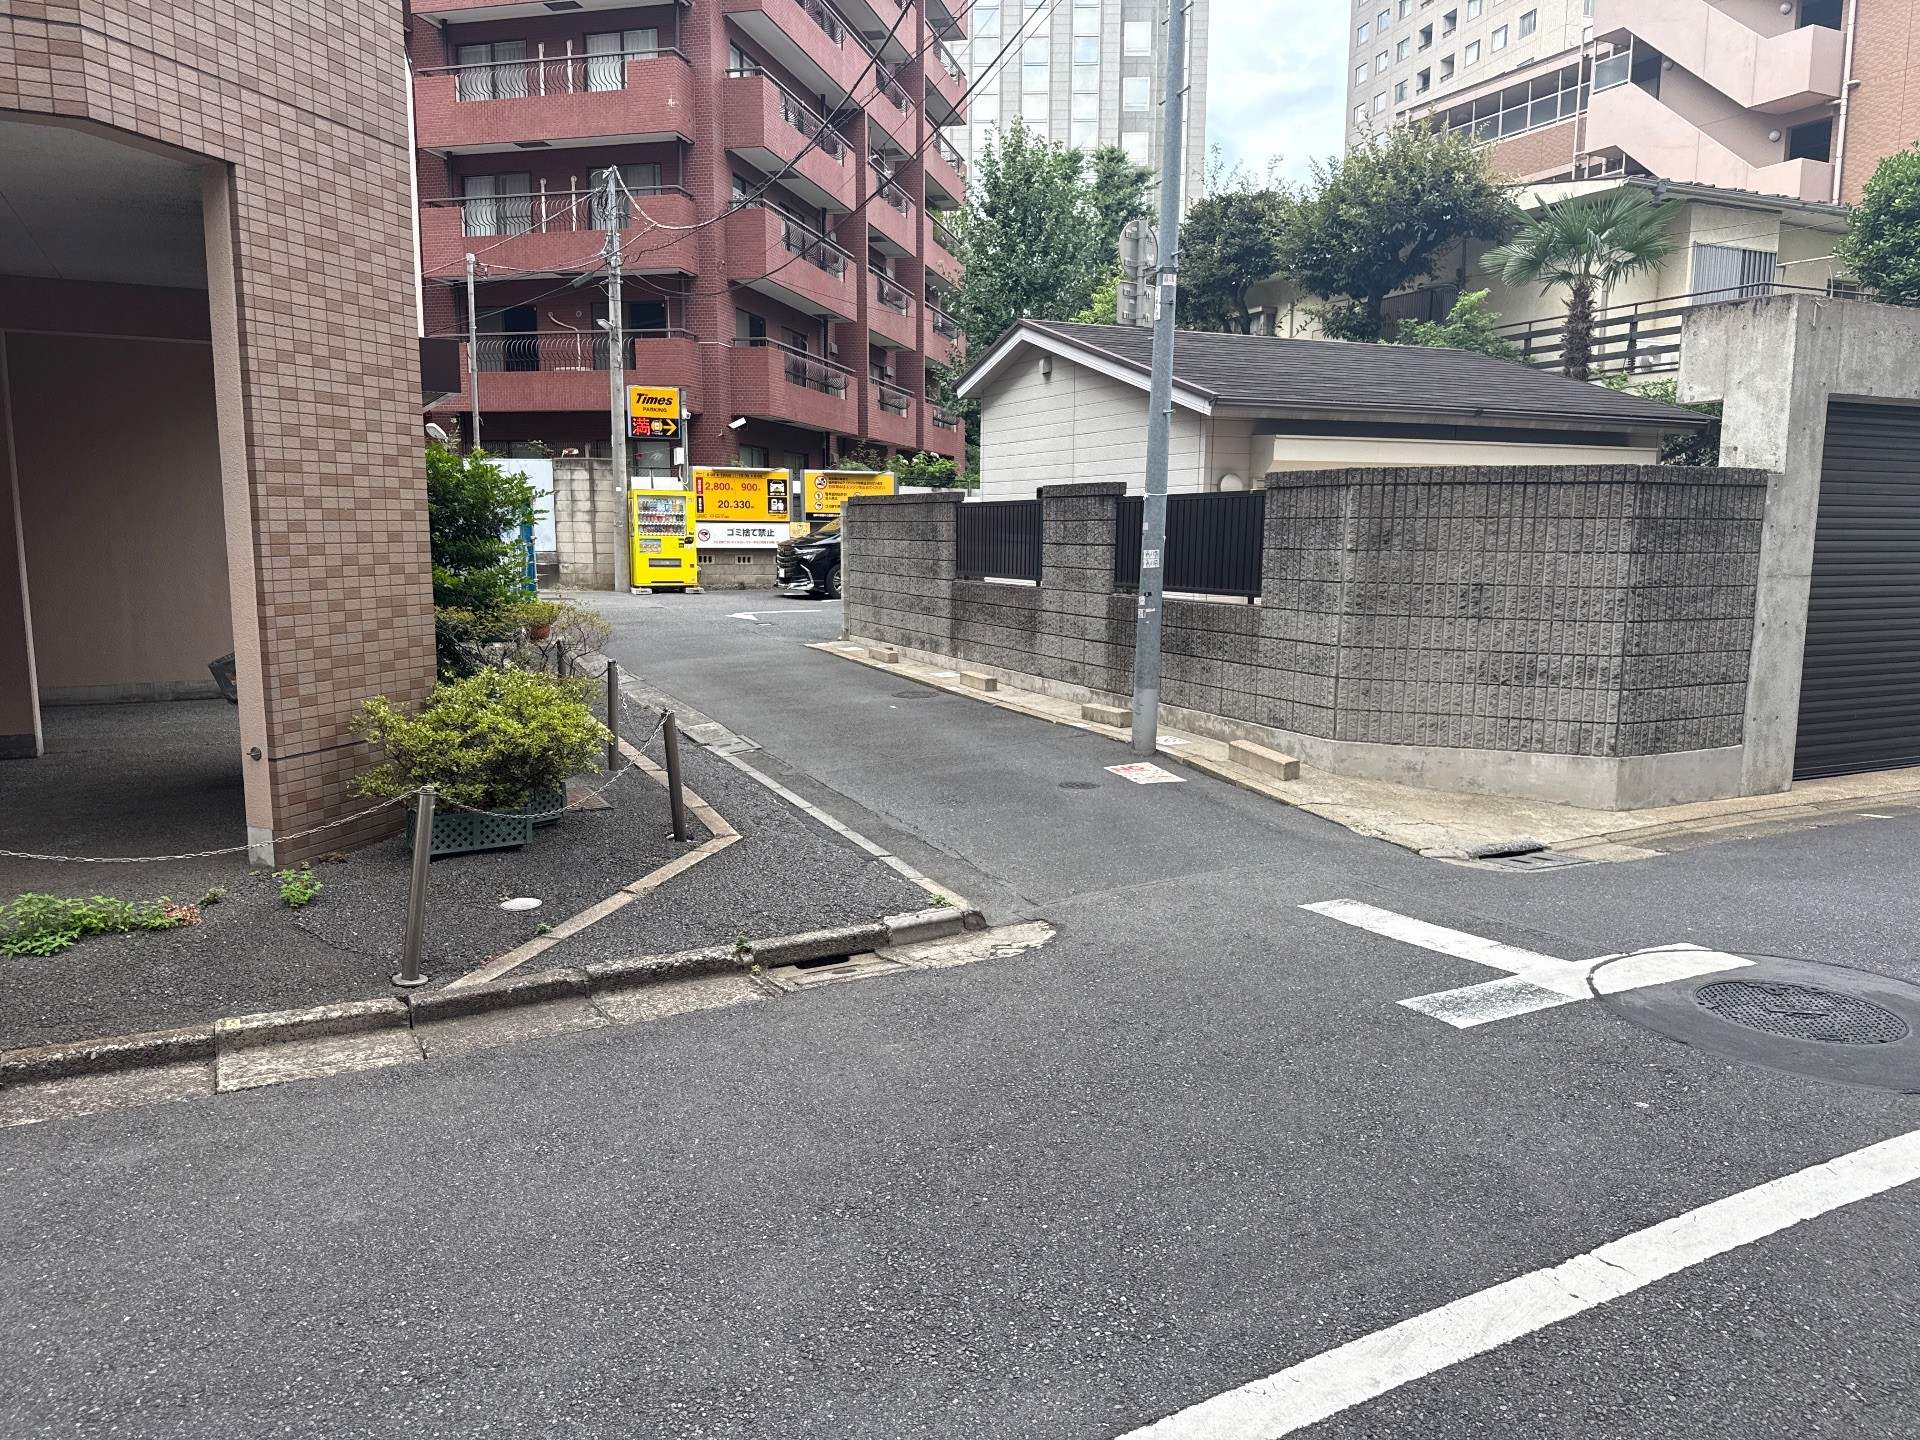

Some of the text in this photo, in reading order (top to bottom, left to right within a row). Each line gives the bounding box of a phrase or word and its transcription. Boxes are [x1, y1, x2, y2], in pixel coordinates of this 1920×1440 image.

[636, 393, 673, 405] Times
[632, 418, 650, 435] 満
[741, 483, 760, 491] 900
[727, 528, 775, 537] ゴミ捨て禁止
